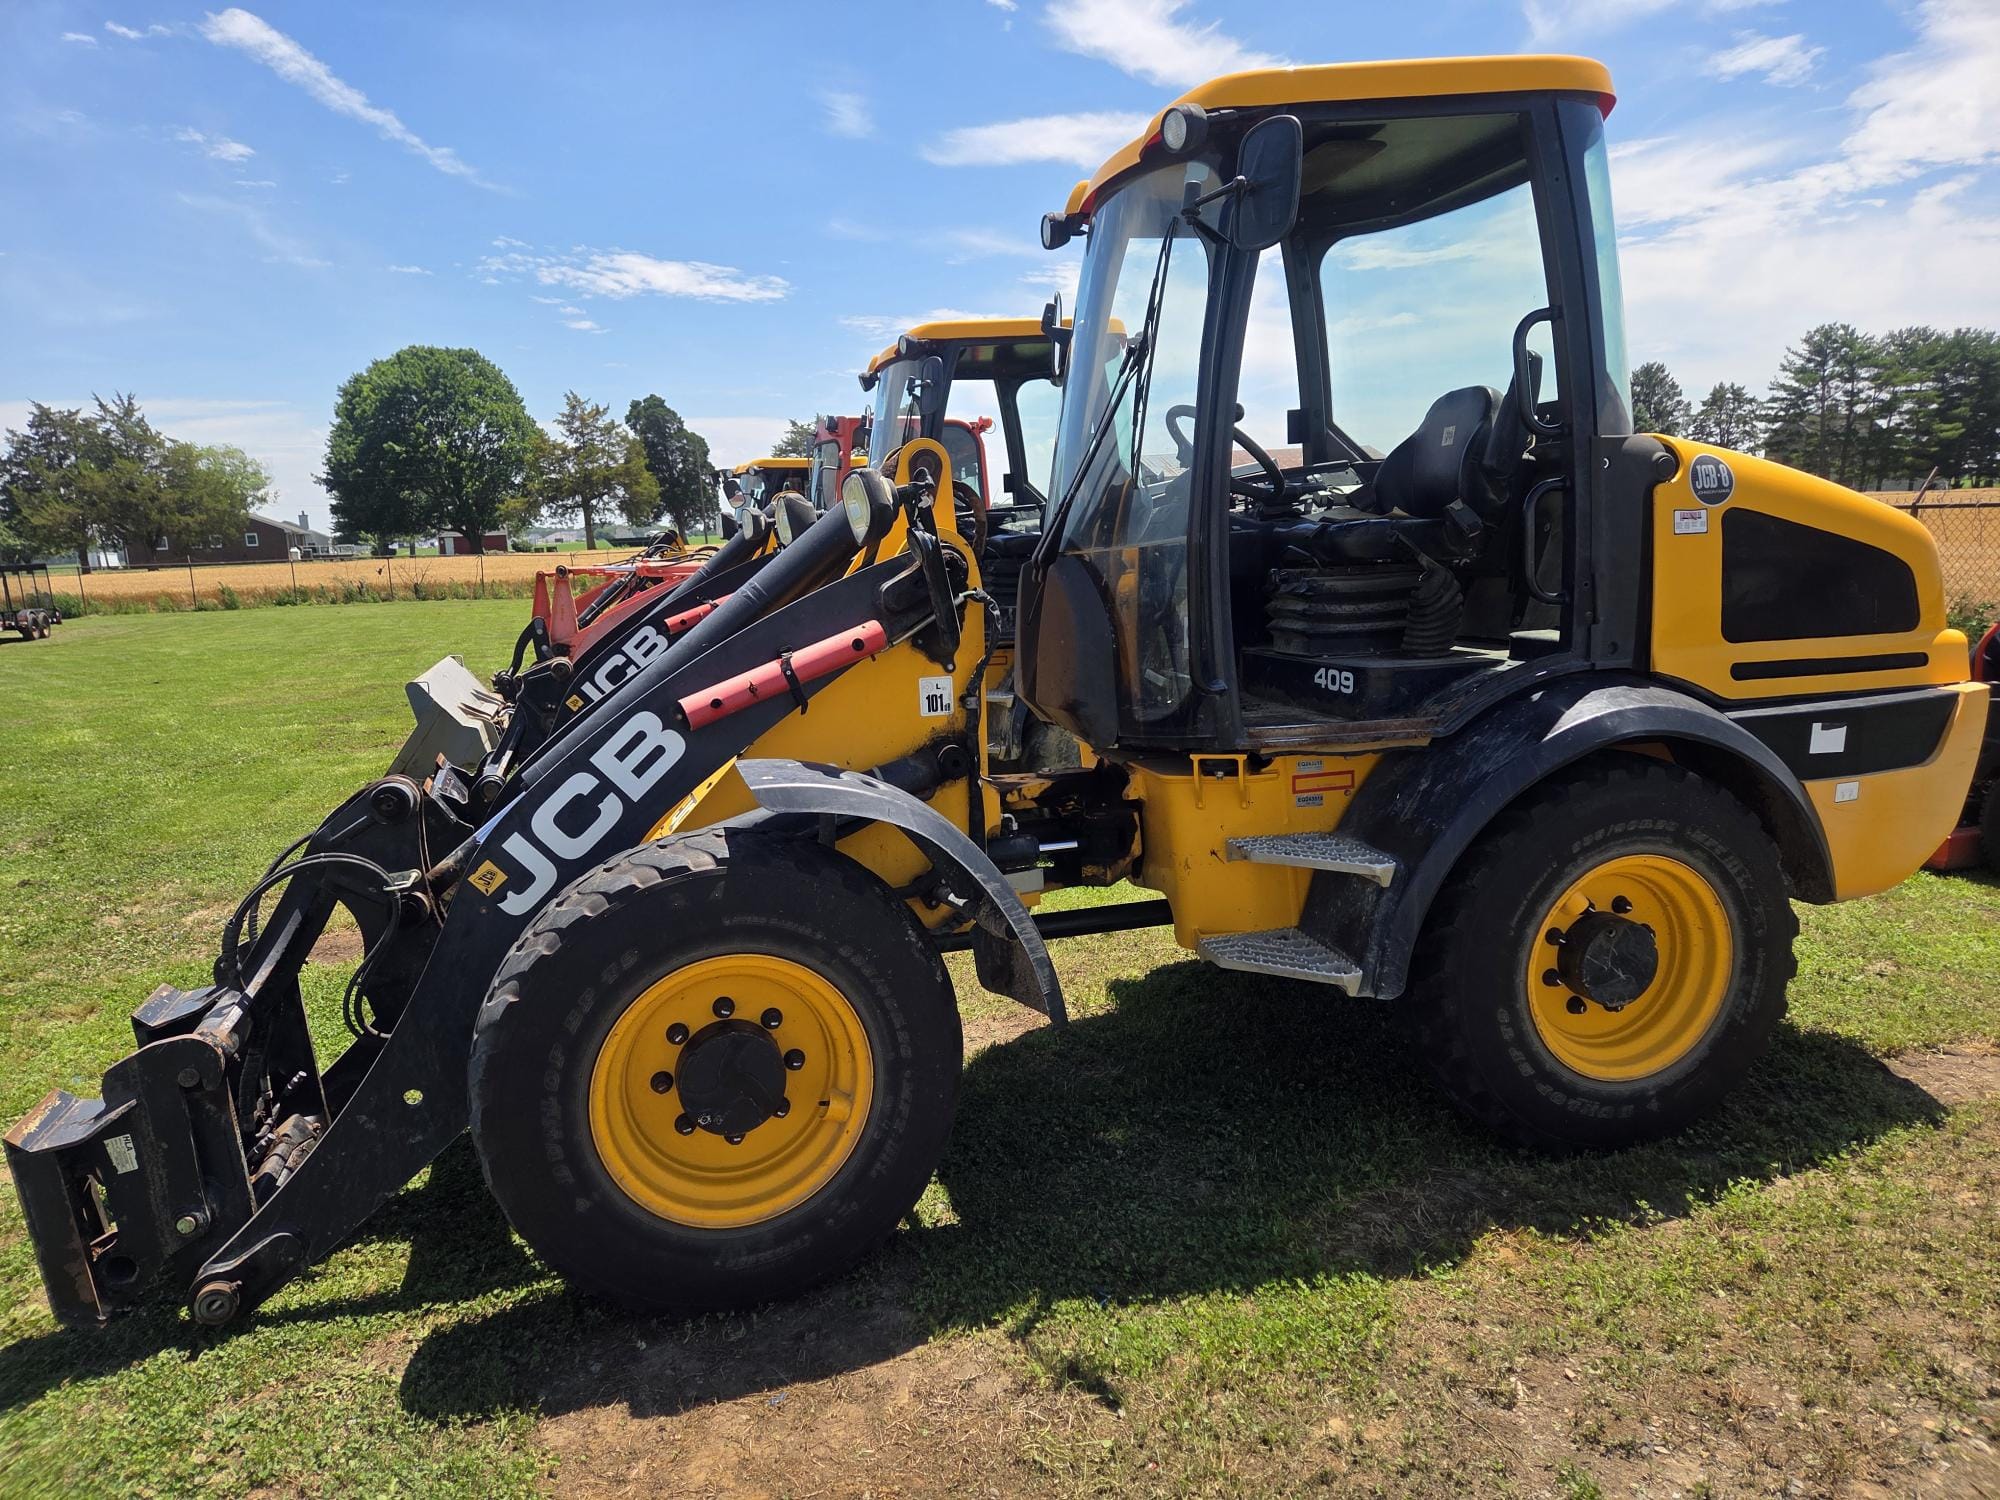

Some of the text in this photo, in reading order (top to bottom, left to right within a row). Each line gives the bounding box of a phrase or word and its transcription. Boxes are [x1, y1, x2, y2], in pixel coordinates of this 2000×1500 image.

[580, 625, 669, 702] JCB
[1314, 667, 1354, 693] 409
[497, 711, 686, 916] JCB
[478, 870, 496, 886] JCB
[122, 1135, 133, 1152] HLA
